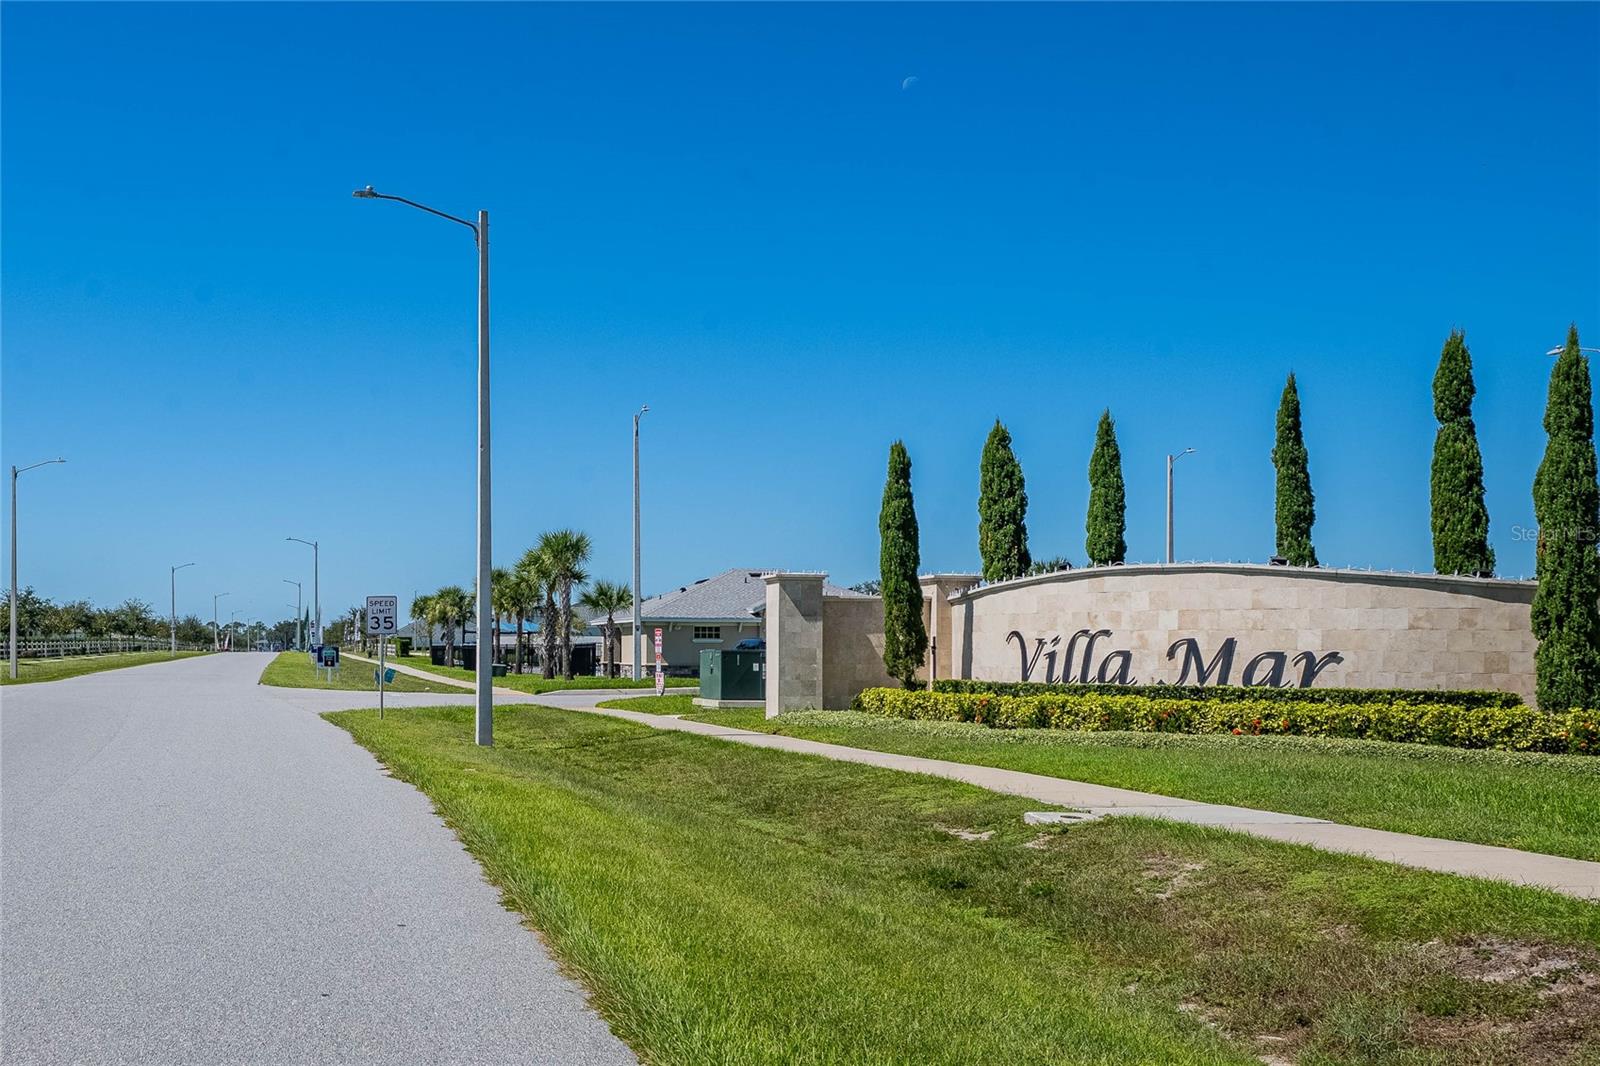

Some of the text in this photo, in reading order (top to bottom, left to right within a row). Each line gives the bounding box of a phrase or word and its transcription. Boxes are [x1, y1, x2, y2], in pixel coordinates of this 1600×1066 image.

[370, 616, 394, 630] 35
[1006, 629, 1345, 689] Villa Mar
